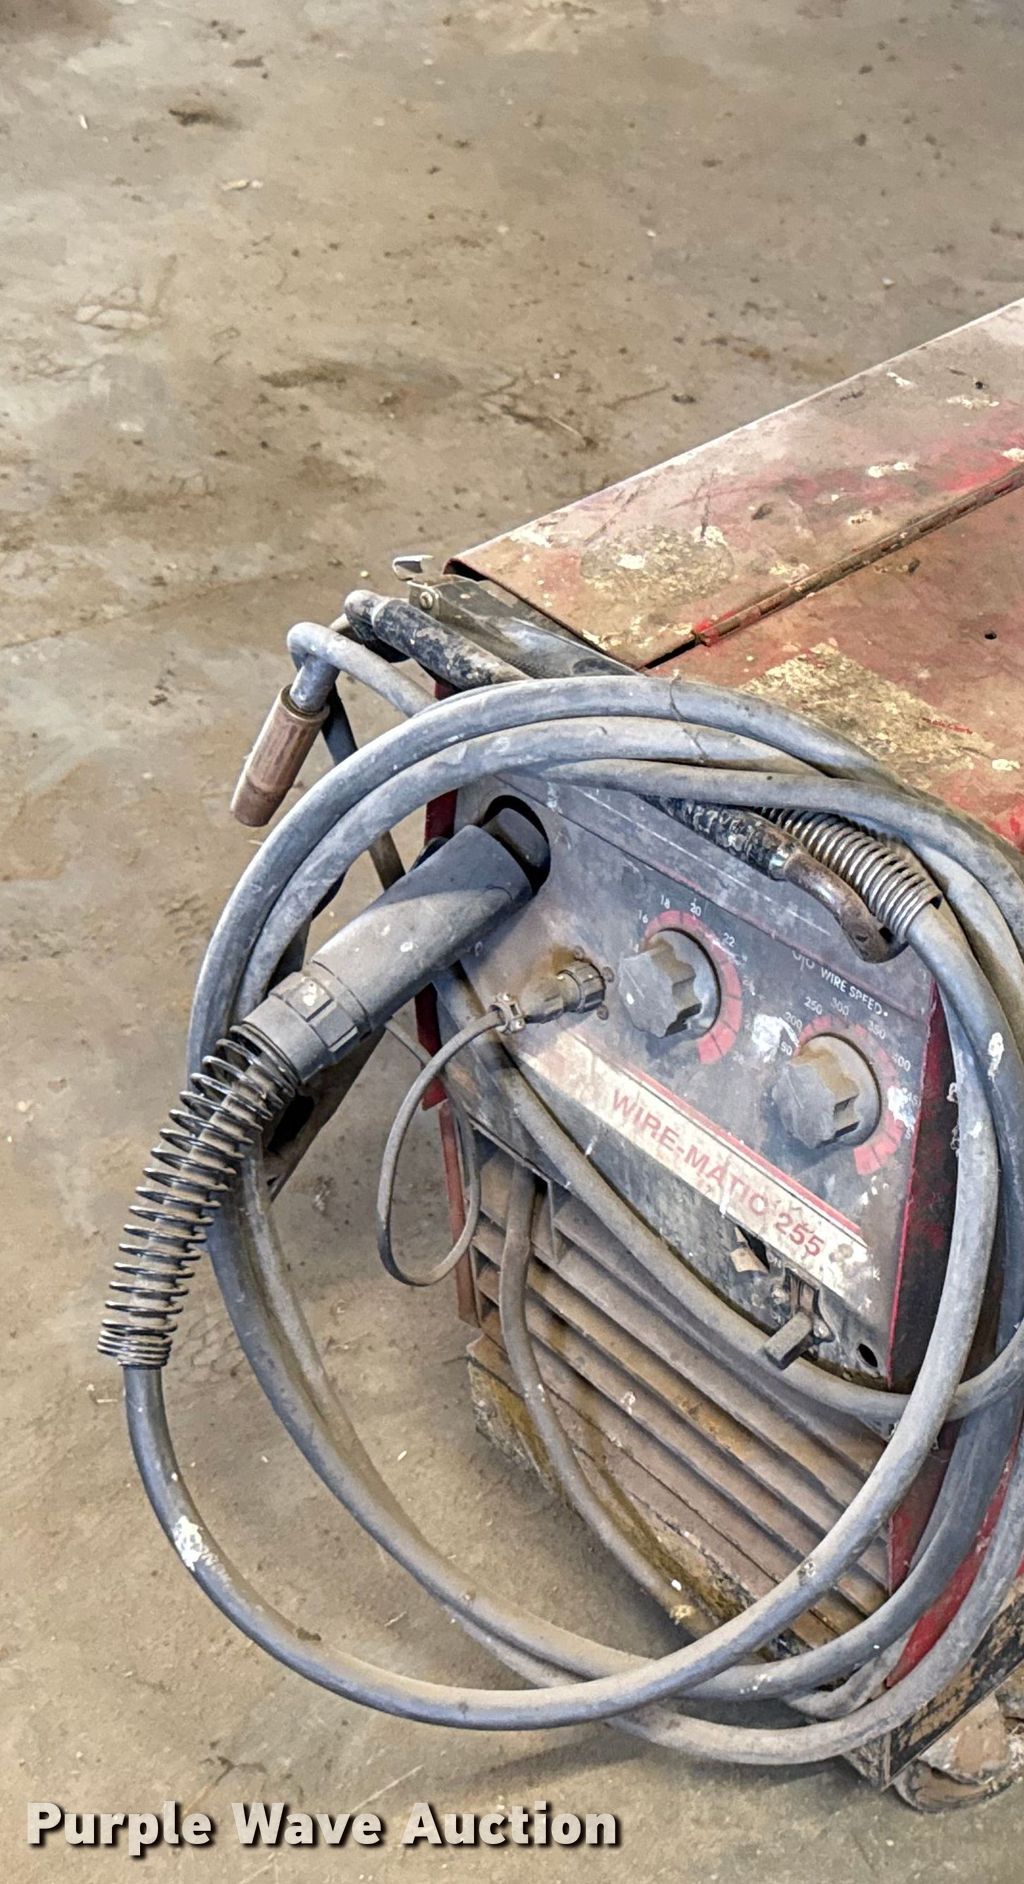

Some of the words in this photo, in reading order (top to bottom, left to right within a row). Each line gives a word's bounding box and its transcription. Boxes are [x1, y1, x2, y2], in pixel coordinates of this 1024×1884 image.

[803, 996, 823, 1016] 250
[820, 967, 848, 993] WIRE
[848, 985, 883, 1016] SPEED
[783, 1011, 803, 1030] 200
[611, 1089, 770, 1217] WIRE-MATIC
[774, 1212, 825, 1257] 255
